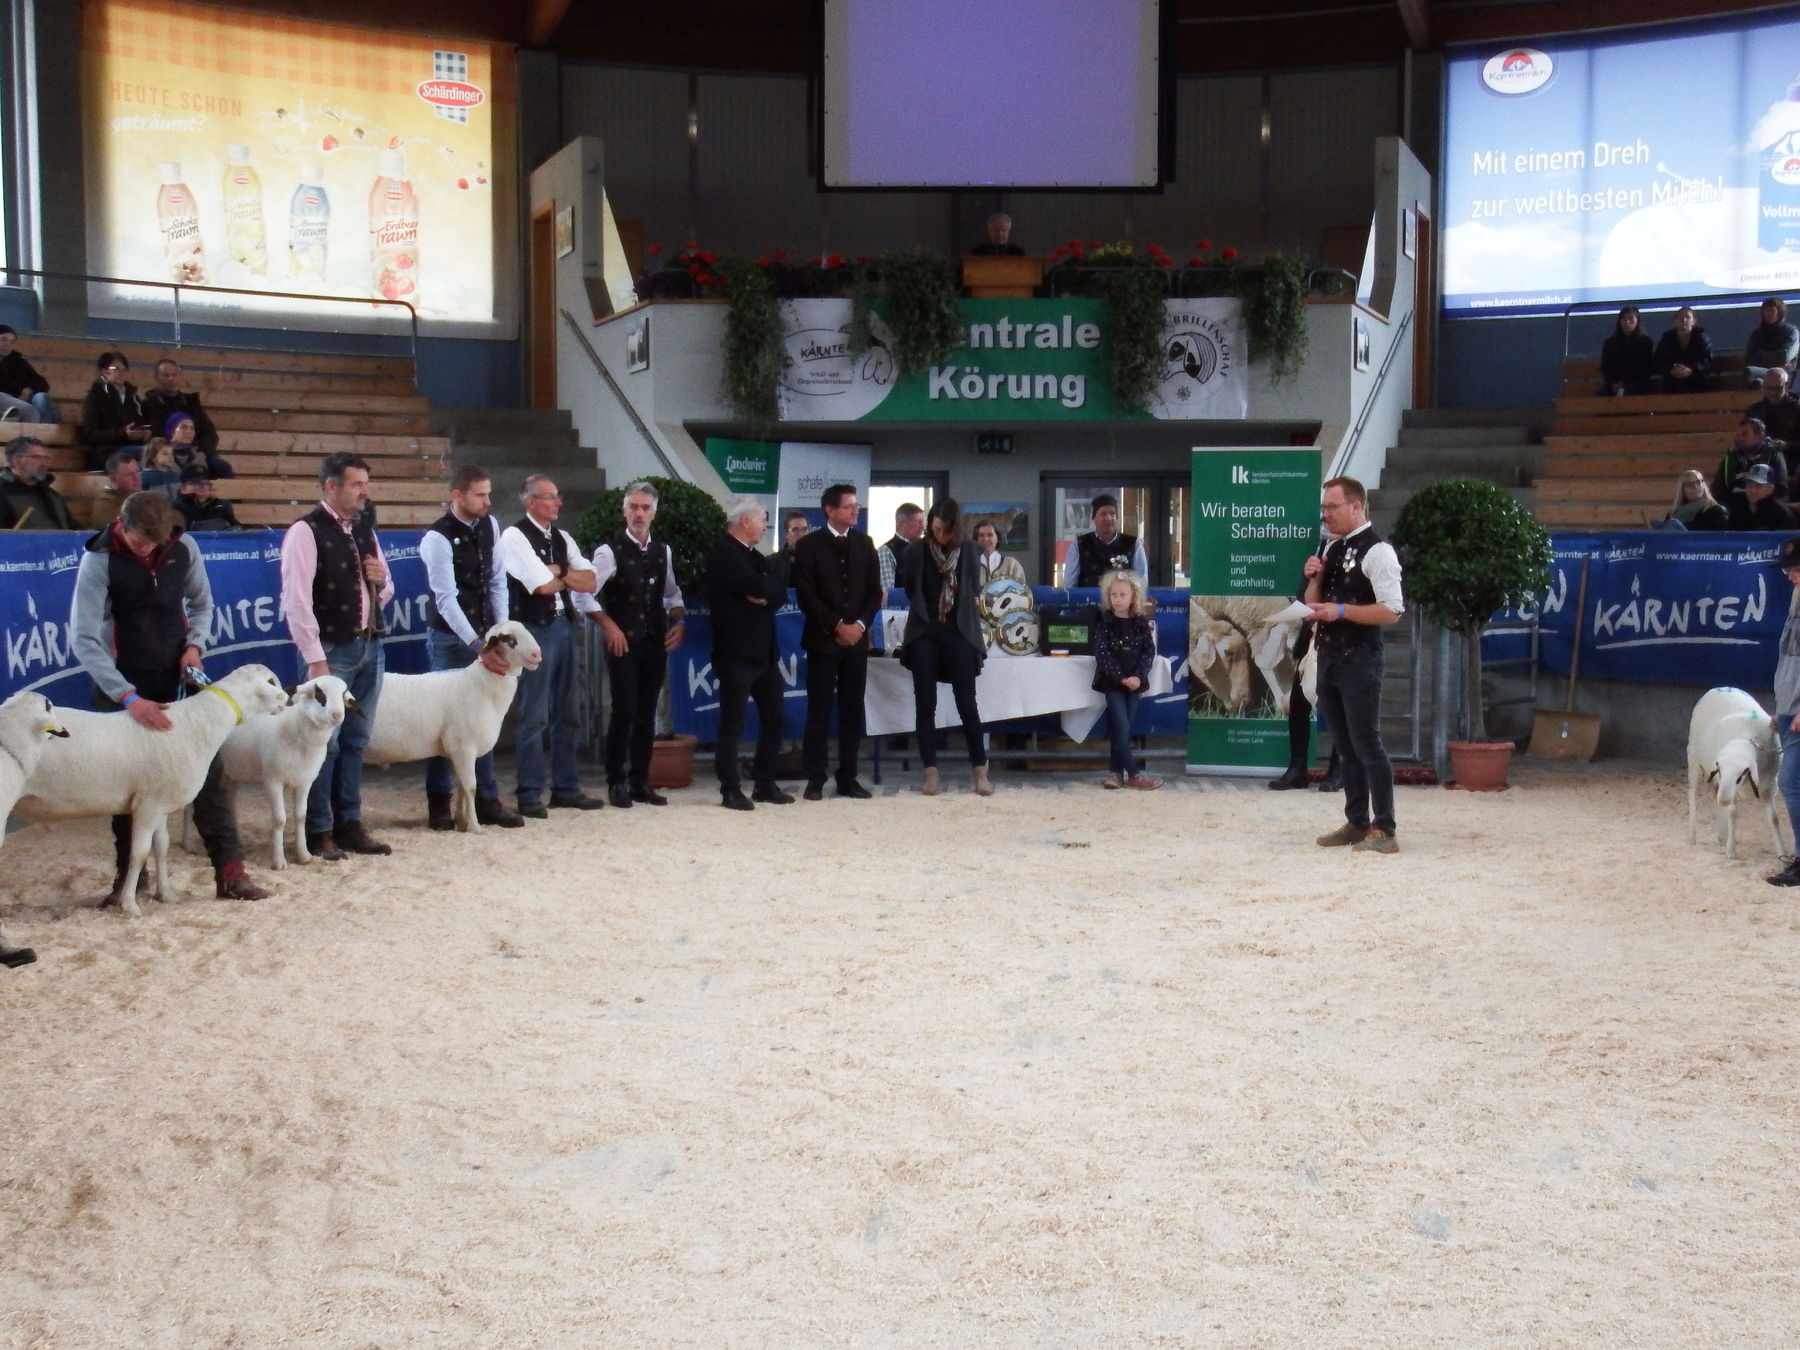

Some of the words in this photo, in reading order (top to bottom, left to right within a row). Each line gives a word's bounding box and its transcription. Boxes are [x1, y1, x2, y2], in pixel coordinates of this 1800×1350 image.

[110, 81, 171, 108] HEUTE
[180, 91, 242, 117] SCHON
[422, 84, 481, 103] Schärdinger
[111, 112, 208, 134] geträumt?
[1473, 149, 1507, 176] Mit
[1514, 147, 1585, 173] einem
[1593, 139, 1650, 168] Dreh
[1471, 199, 1508, 219] zur
[1515, 188, 1643, 216] weltbesten
[1652, 175, 1724, 208] Milch!
[161, 225, 199, 244] Traum
[370, 227, 417, 249] Traum
[1470, 295, 1572, 308] www.kaerntnermilch.at
[959, 315, 1100, 349] ntrale
[929, 366, 1086, 408] Körung
[1232, 465, 1249, 484] lk
[1201, 502, 1227, 518] Wir
[1232, 502, 1285, 518] beraten
[1231, 522, 1312, 539] Schafhalter
[1230, 553, 1276, 563] kompetent
[1656, 552, 1732, 561] www.kaernten.at
[1230, 566, 1247, 575] und
[1230, 578, 1275, 590] nachhaltig
